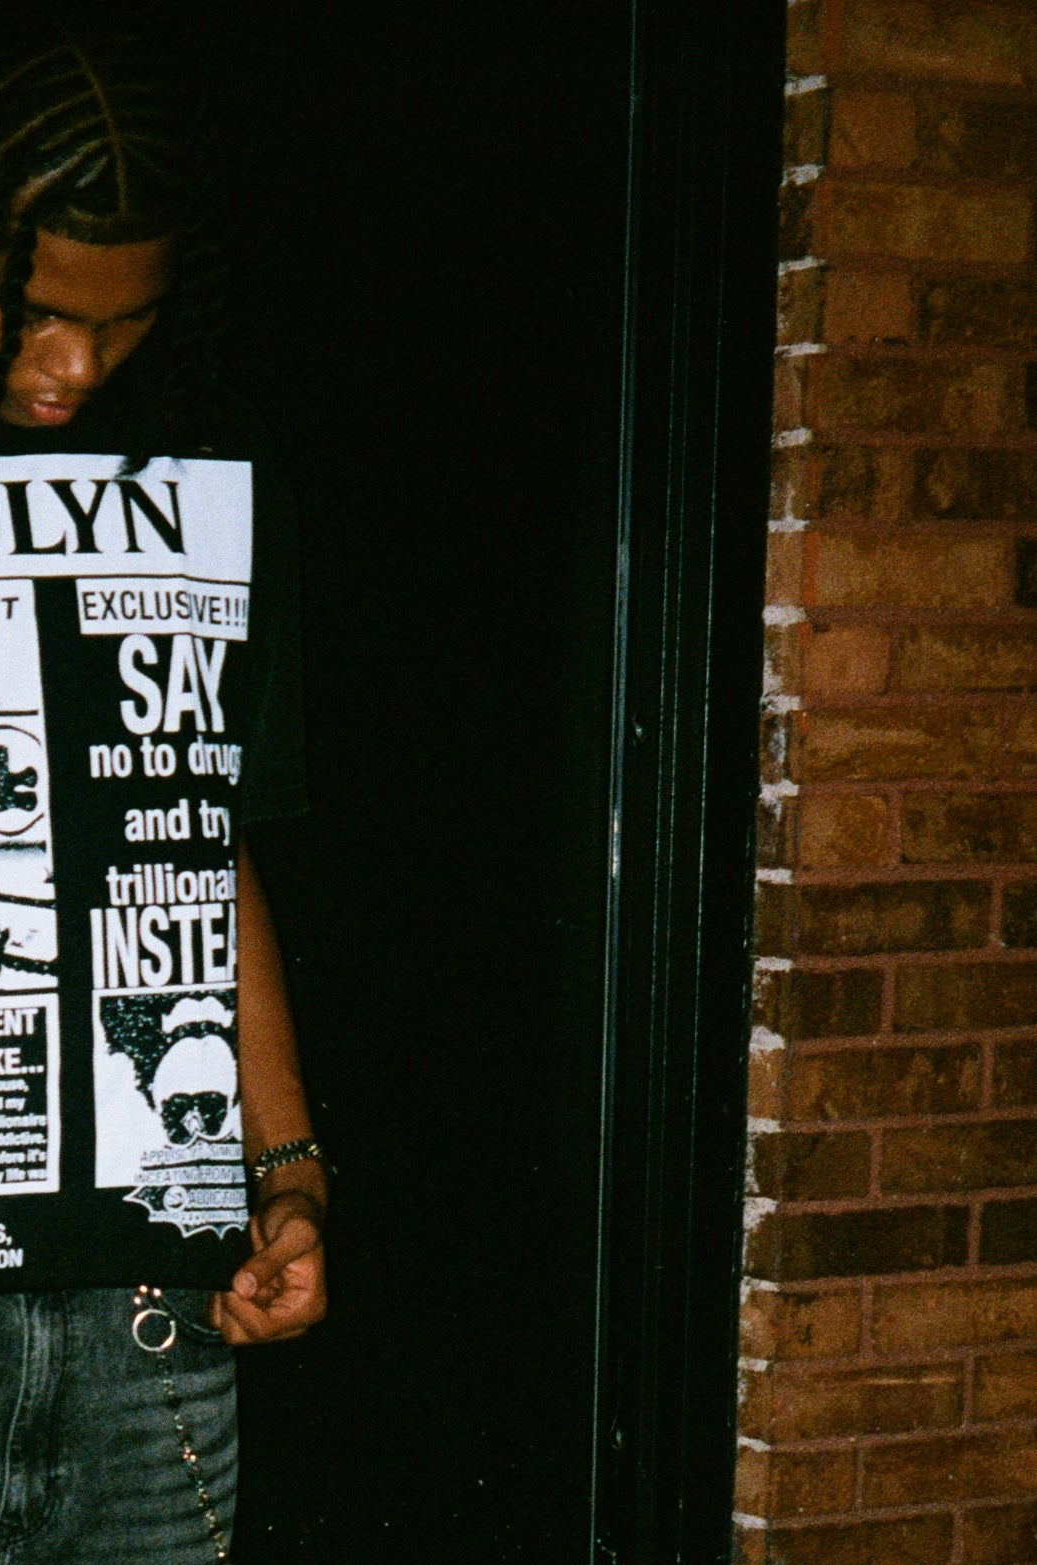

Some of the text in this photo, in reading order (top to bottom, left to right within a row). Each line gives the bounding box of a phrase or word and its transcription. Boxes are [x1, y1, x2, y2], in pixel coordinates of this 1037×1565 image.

[118, 633, 227, 736] SAY
[89, 743, 133, 779] no
[140, 736, 177, 778] to
[124, 798, 230, 847] and try
